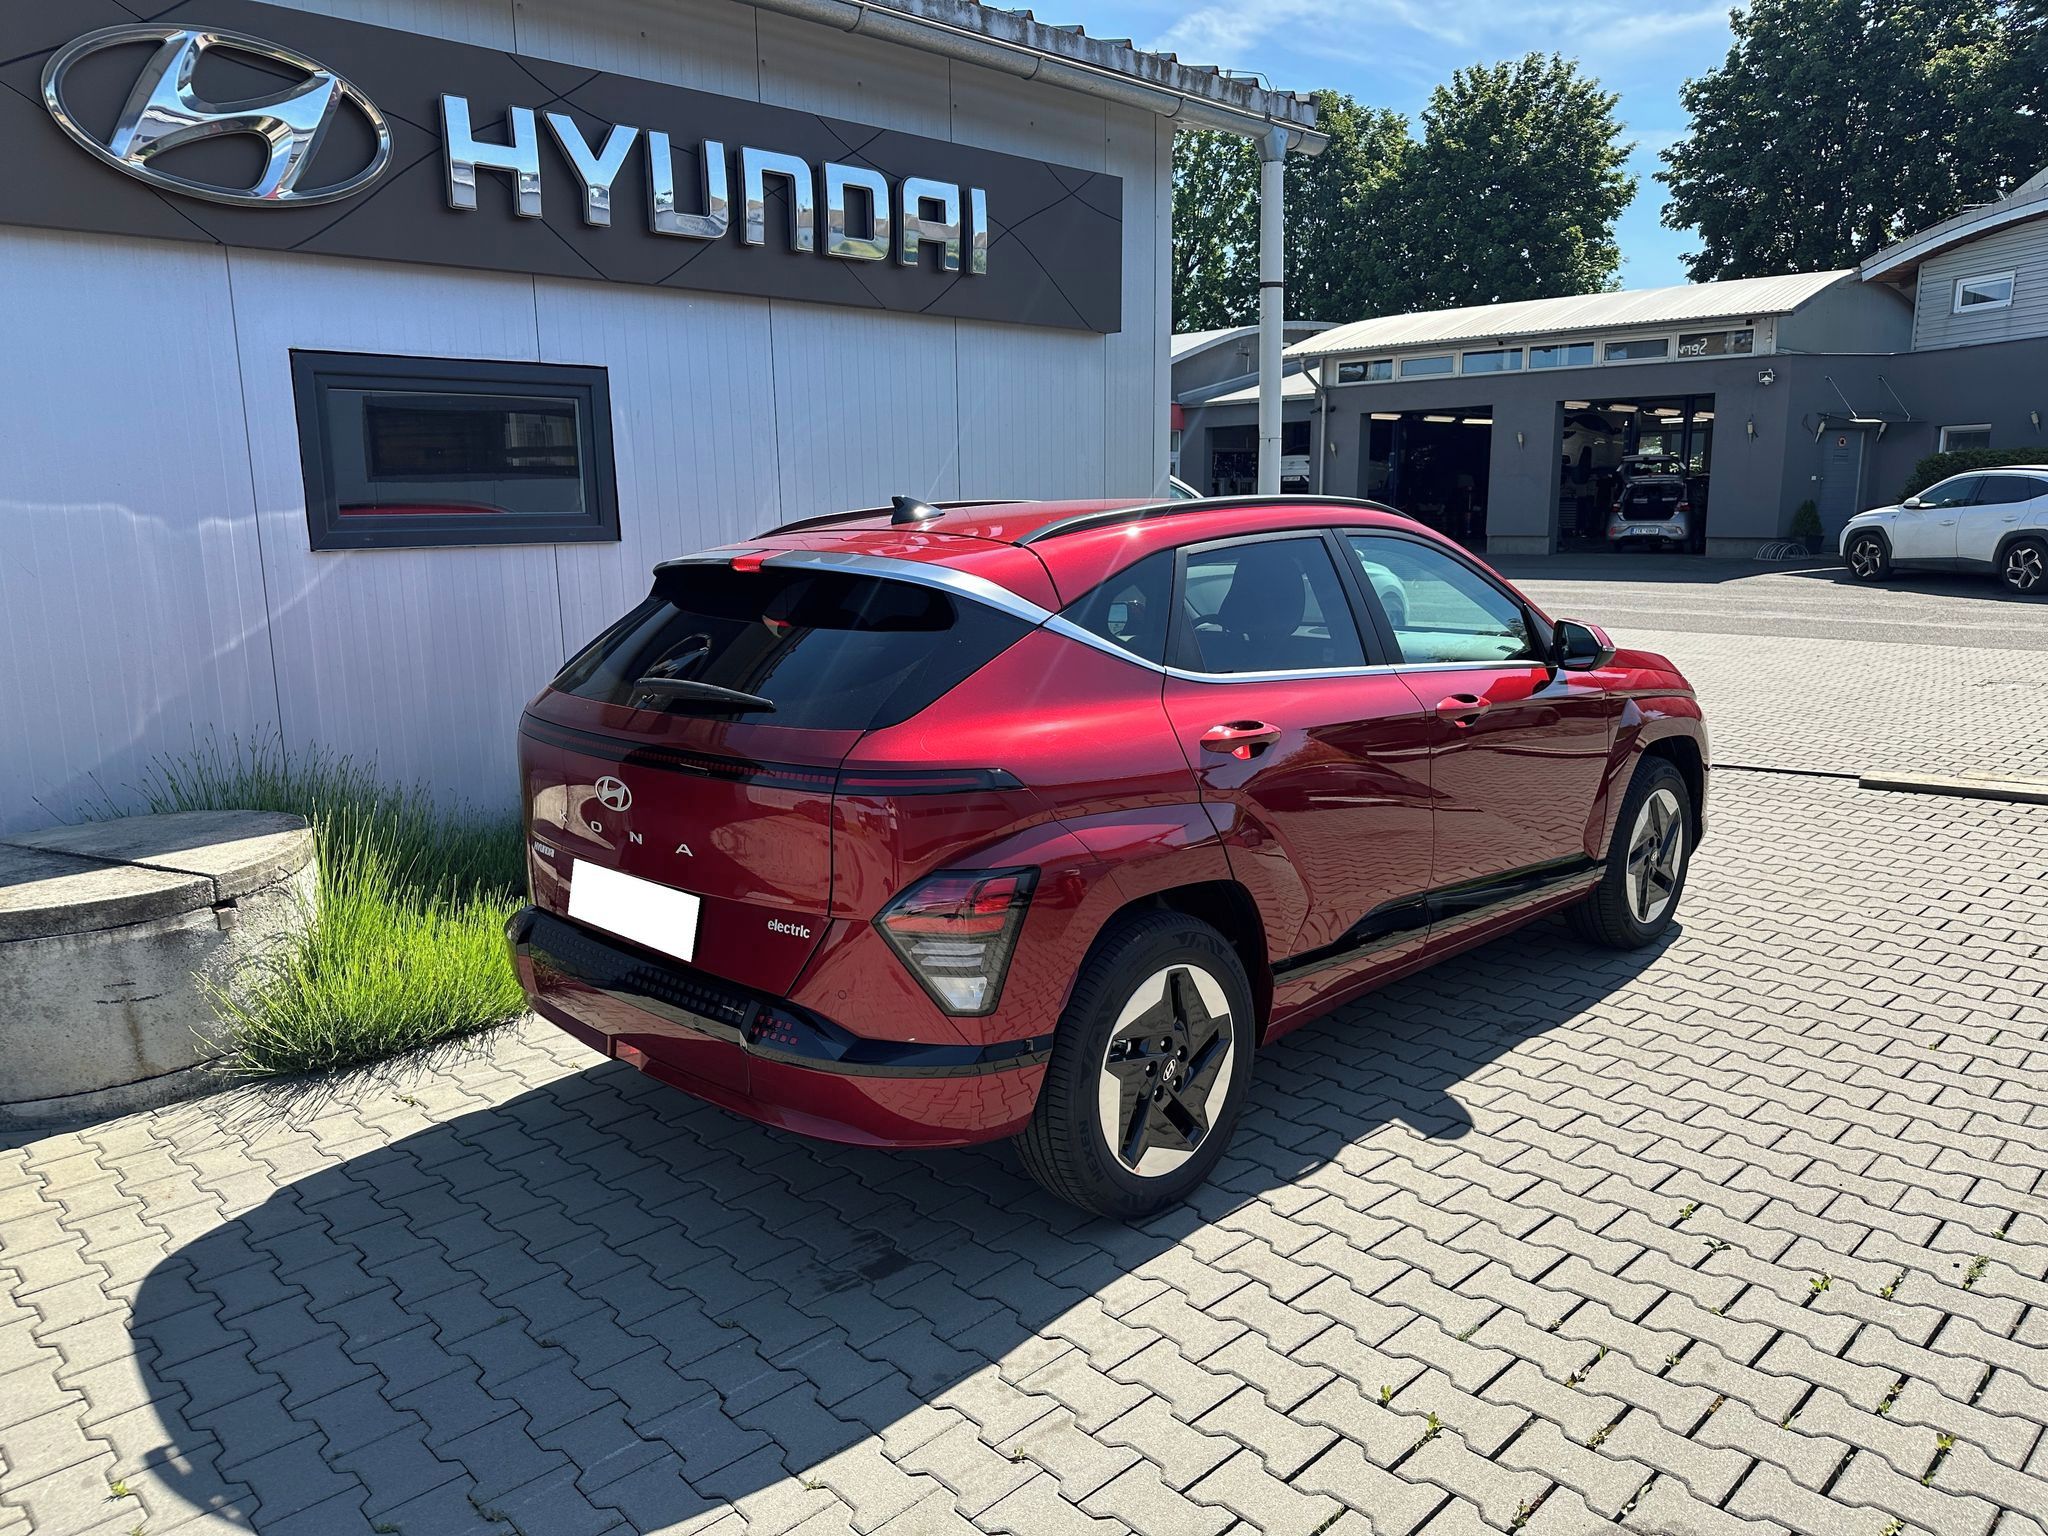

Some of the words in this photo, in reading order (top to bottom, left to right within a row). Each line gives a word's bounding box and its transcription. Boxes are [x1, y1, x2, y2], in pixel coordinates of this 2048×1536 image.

[440, 93, 988, 276] HYUNDAI
[559, 809, 694, 857] KONA
[767, 919, 811, 939] electric
[1078, 1119, 1105, 1183] NEXEN
